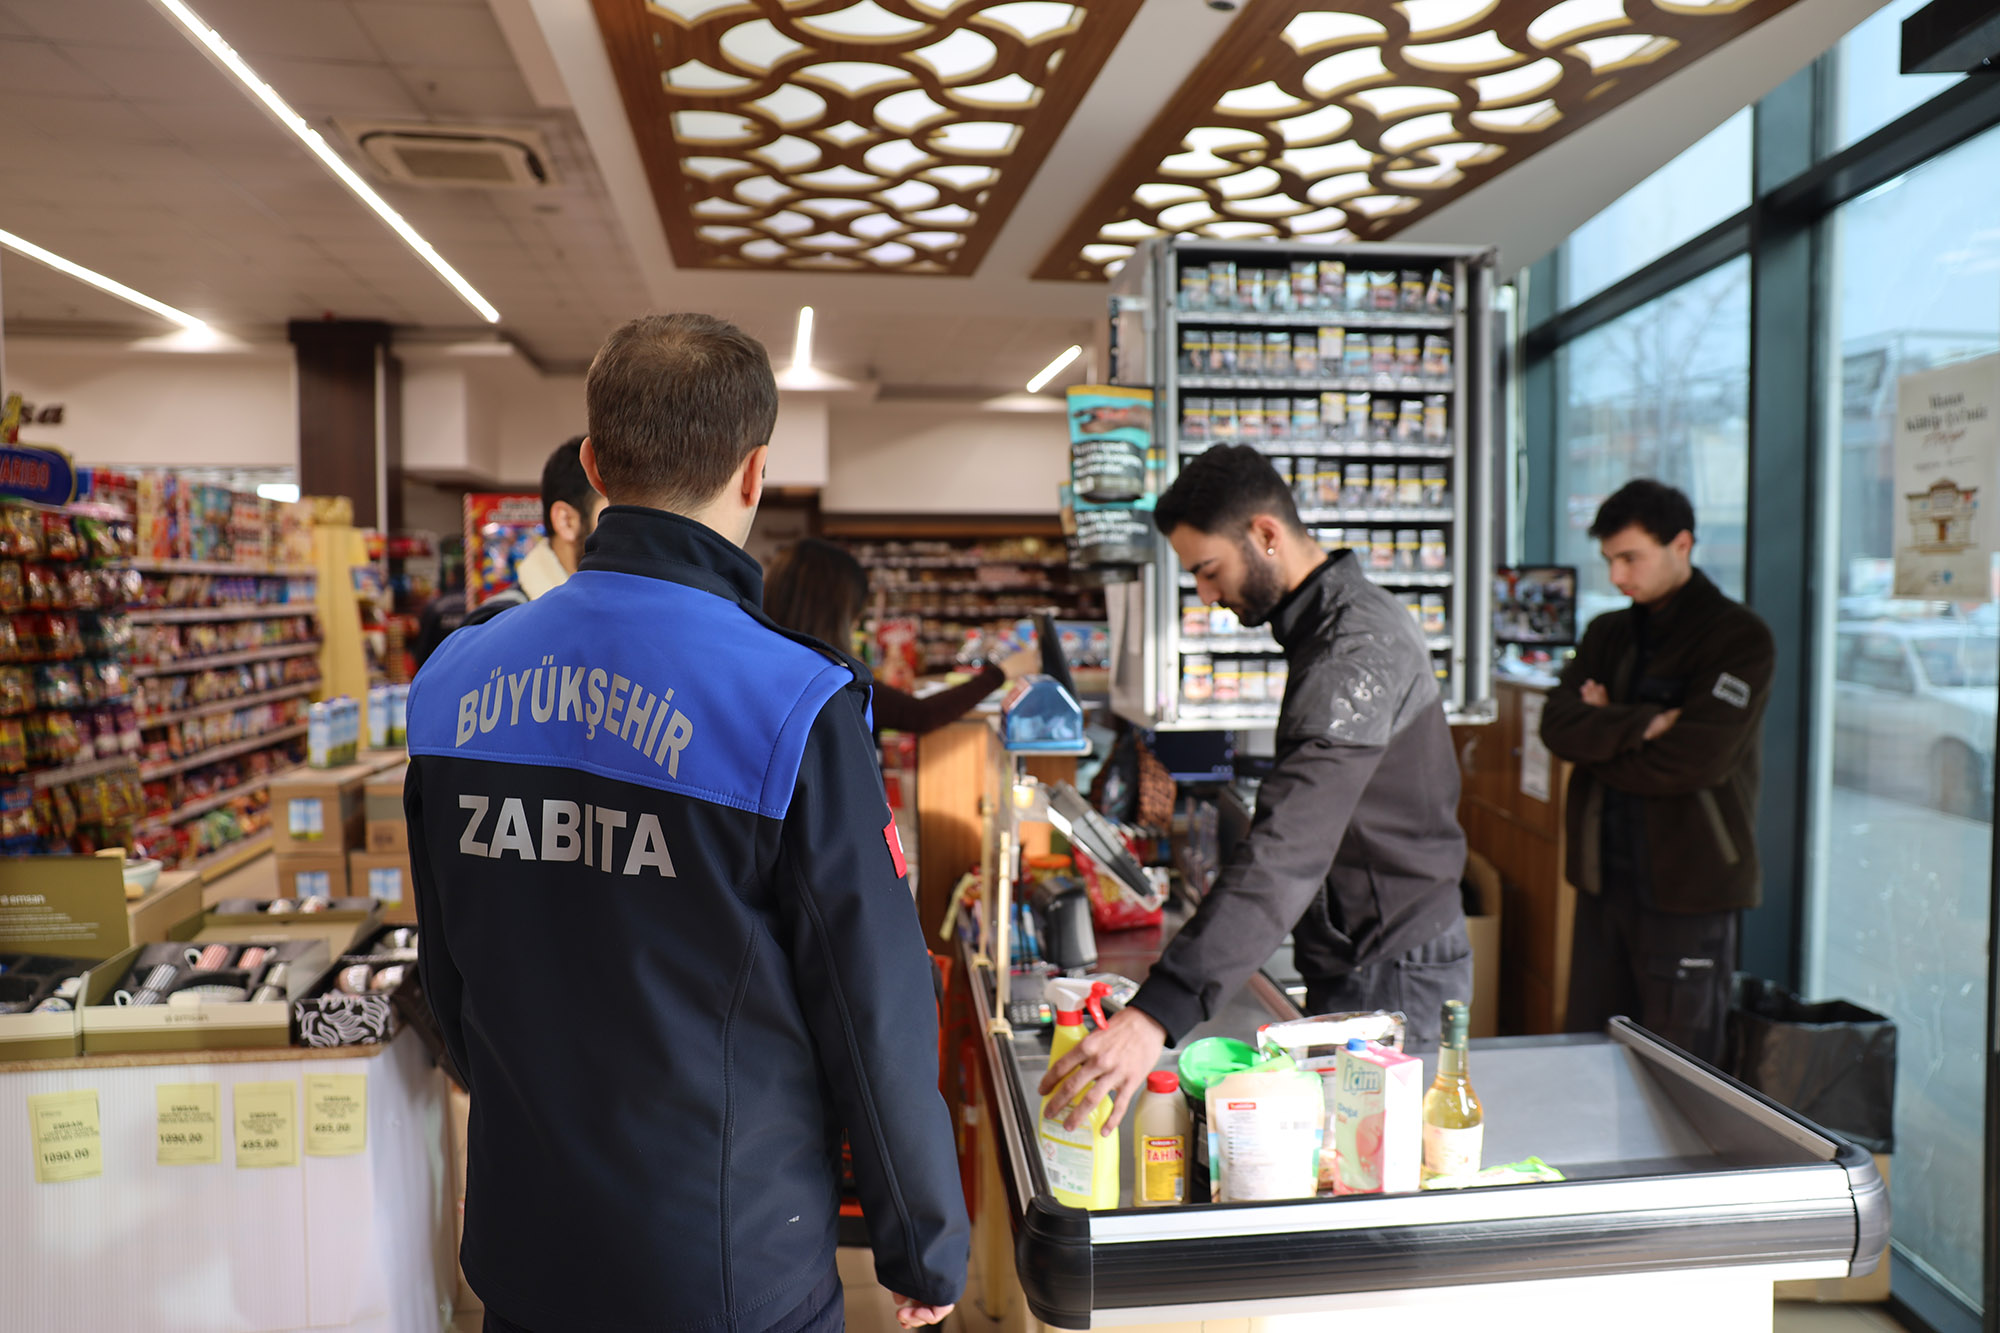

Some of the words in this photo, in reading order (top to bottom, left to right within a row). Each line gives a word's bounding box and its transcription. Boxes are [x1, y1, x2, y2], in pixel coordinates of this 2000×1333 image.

[0, 456, 50, 490] ARIBO
[455, 654, 694, 780] BÜYÜKŞEHİR
[458, 794, 677, 878] ZABITA
[1343, 1058, 1380, 1095] İçim
